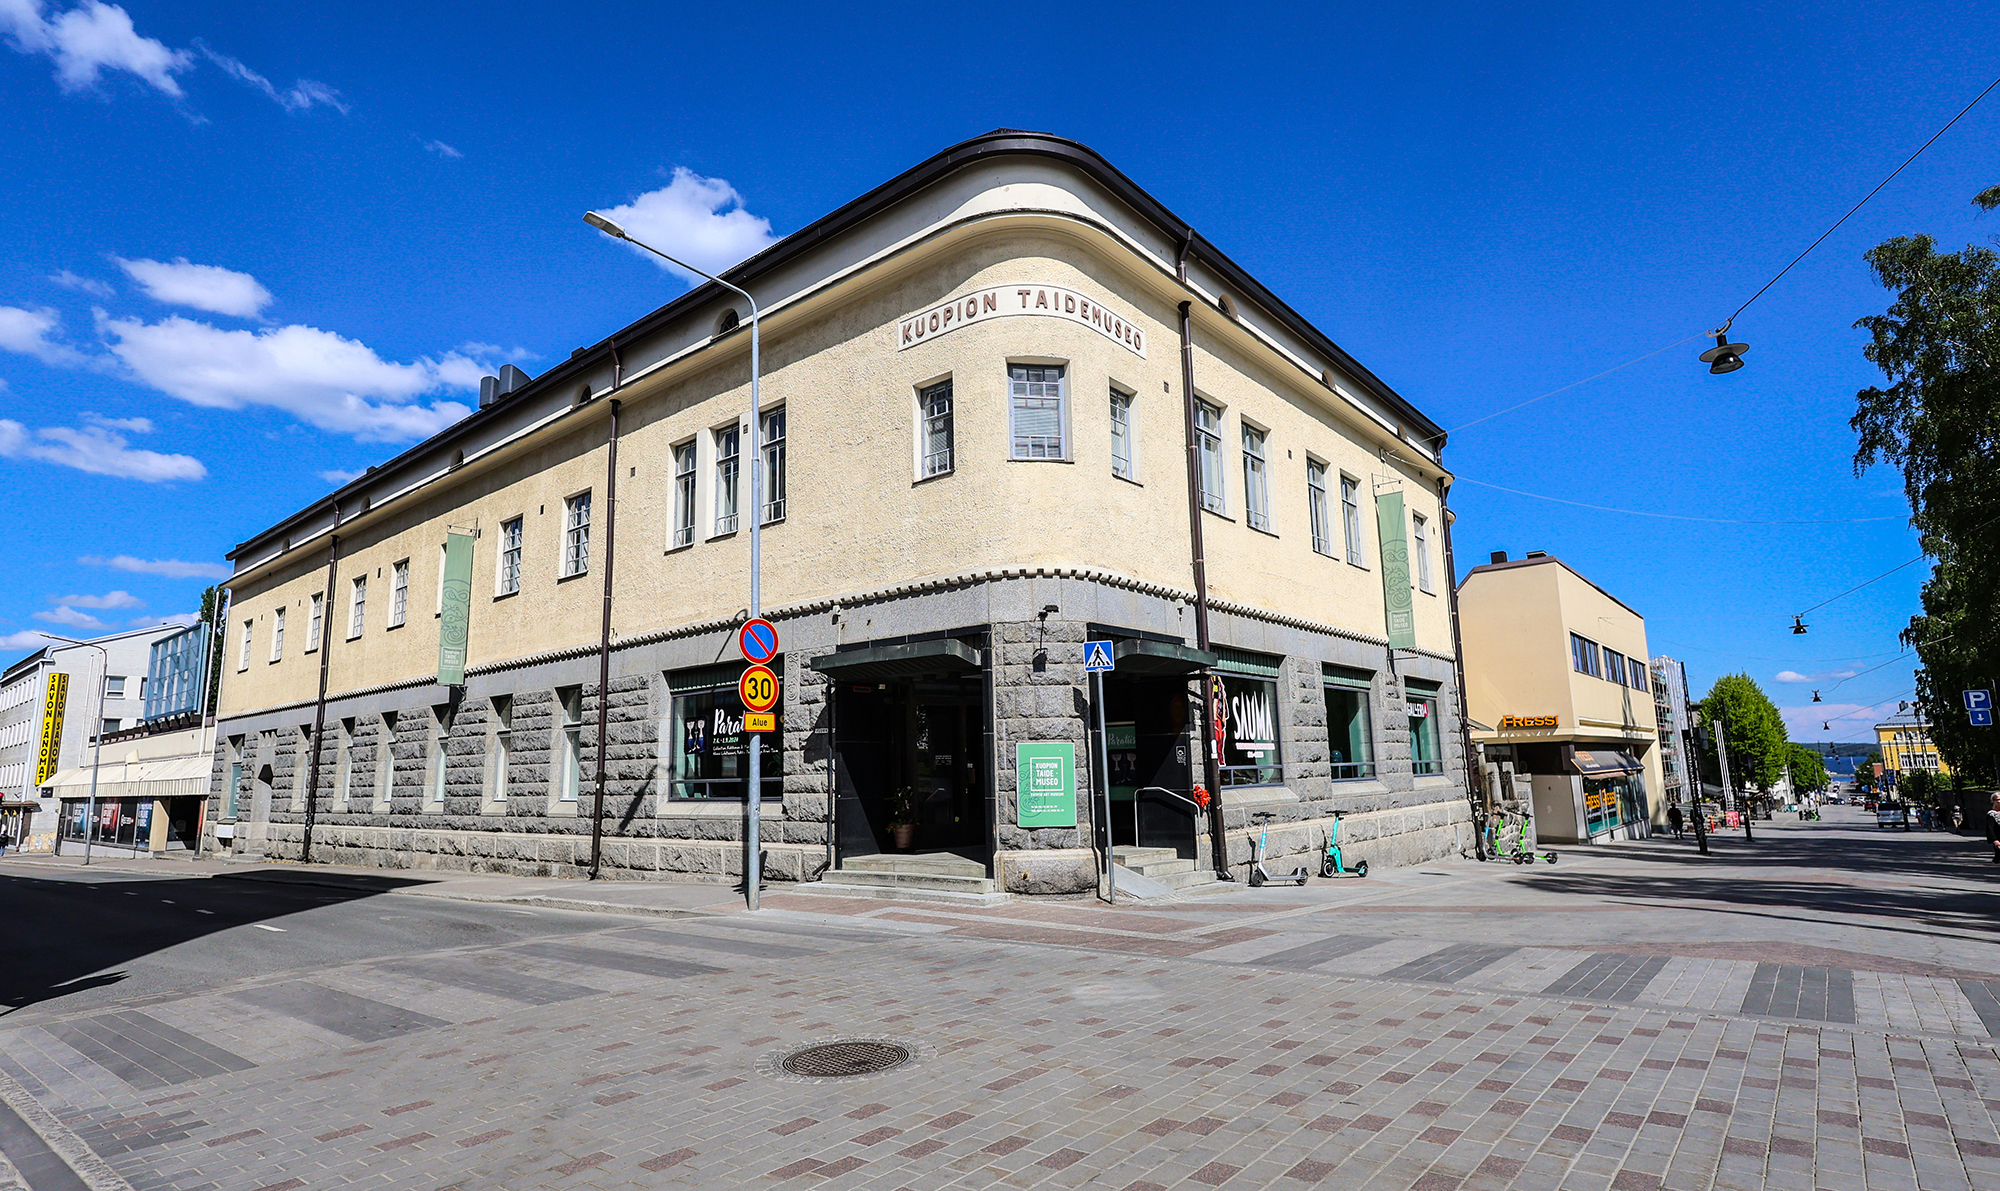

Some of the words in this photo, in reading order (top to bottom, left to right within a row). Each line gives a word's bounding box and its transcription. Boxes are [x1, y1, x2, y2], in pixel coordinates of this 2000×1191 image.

[902, 291, 997, 345] KUOPION
[1017, 289, 1143, 351] TAIDEMUSEO
[46, 675, 56, 718] SAVON
[57, 675, 67, 718] SAVON
[747, 677, 771, 700] 30
[1969, 692, 1986, 708] P
[713, 708, 745, 735] Parat
[752, 718, 768, 726] Alue
[1232, 691, 1274, 740] SAUMA
[1502, 714, 1559, 728] FRESSI
[38, 721, 50, 783] SANOMAT
[1035, 778, 1059, 786] MUSEO
